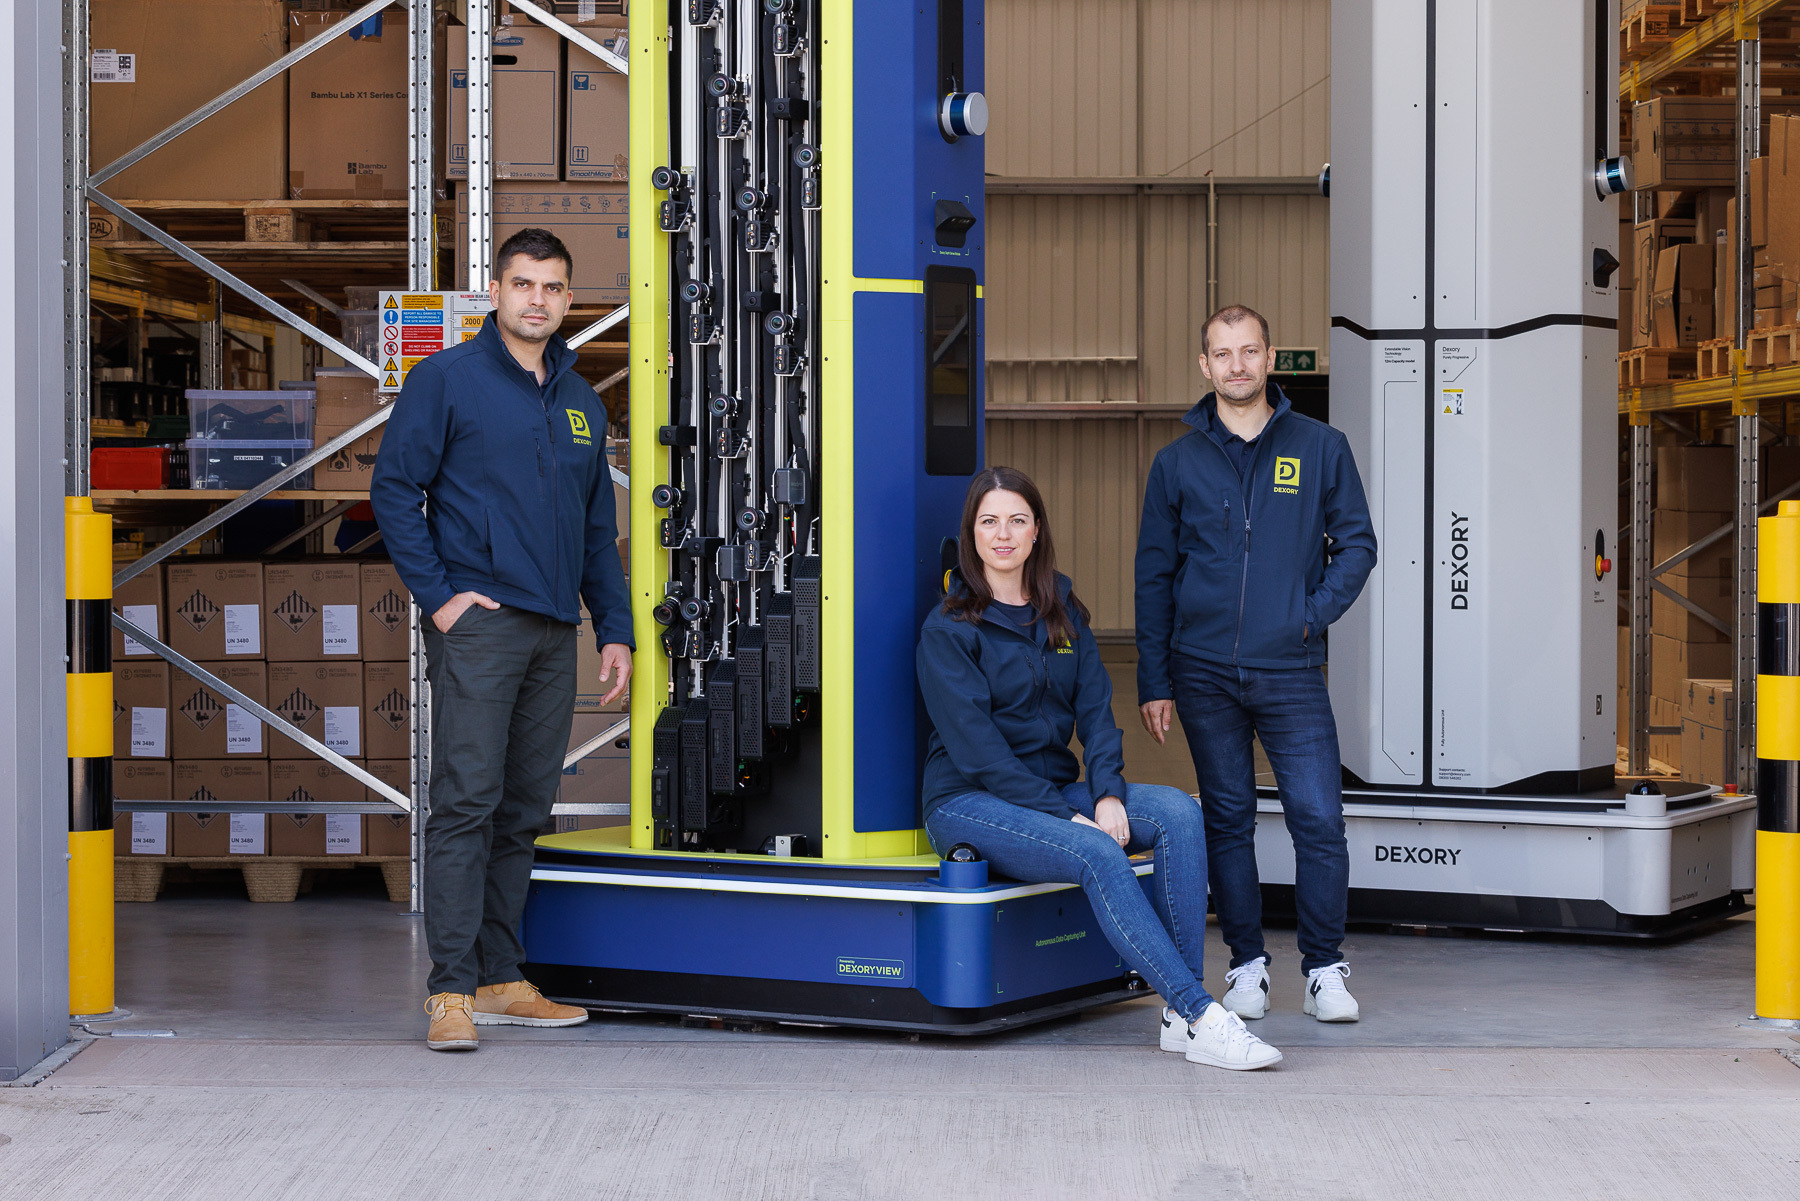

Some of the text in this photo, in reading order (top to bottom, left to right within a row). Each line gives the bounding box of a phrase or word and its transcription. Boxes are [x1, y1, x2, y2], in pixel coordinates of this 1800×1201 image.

[90, 222, 108, 233] PAL
[573, 438, 592, 446] DEXORY
[1451, 511, 1468, 610] DEXORY
[1376, 845, 1461, 865] DEXORY
[1036, 938, 1056, 947] Autonomous
